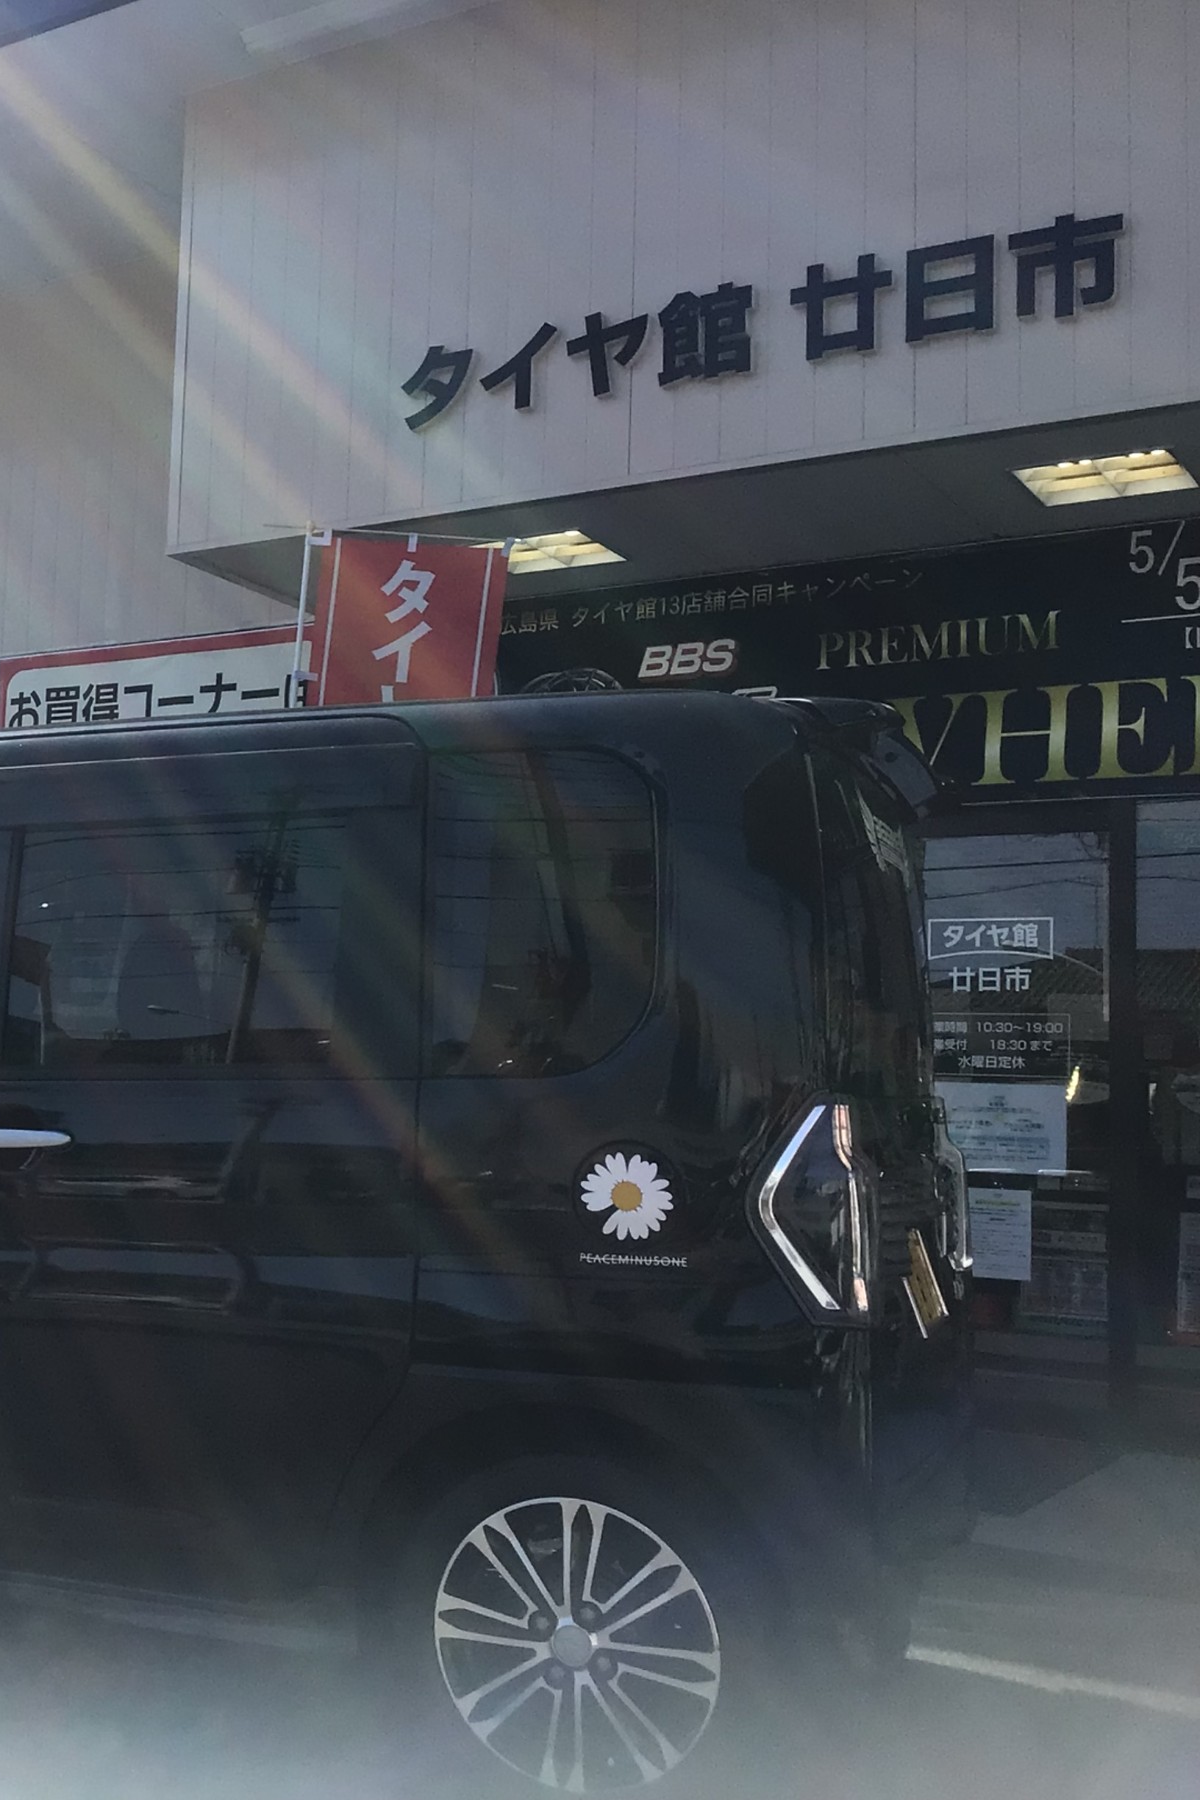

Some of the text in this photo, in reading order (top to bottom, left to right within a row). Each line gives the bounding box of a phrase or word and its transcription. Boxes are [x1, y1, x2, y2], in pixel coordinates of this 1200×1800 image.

[401, 213, 1124, 431] タイヤ館 廿日市
[372, 560, 437, 703] タイ
[816, 609, 1061, 671] PREMIUM
[637, 638, 737, 679] BBS
[943, 922, 1039, 948] タイヤ館
[949, 966, 1032, 992] 廿日市
[958, 1055, 1026, 1069] 水曜日定休
[579, 1252, 688, 1268] PEACEMINUSONE
